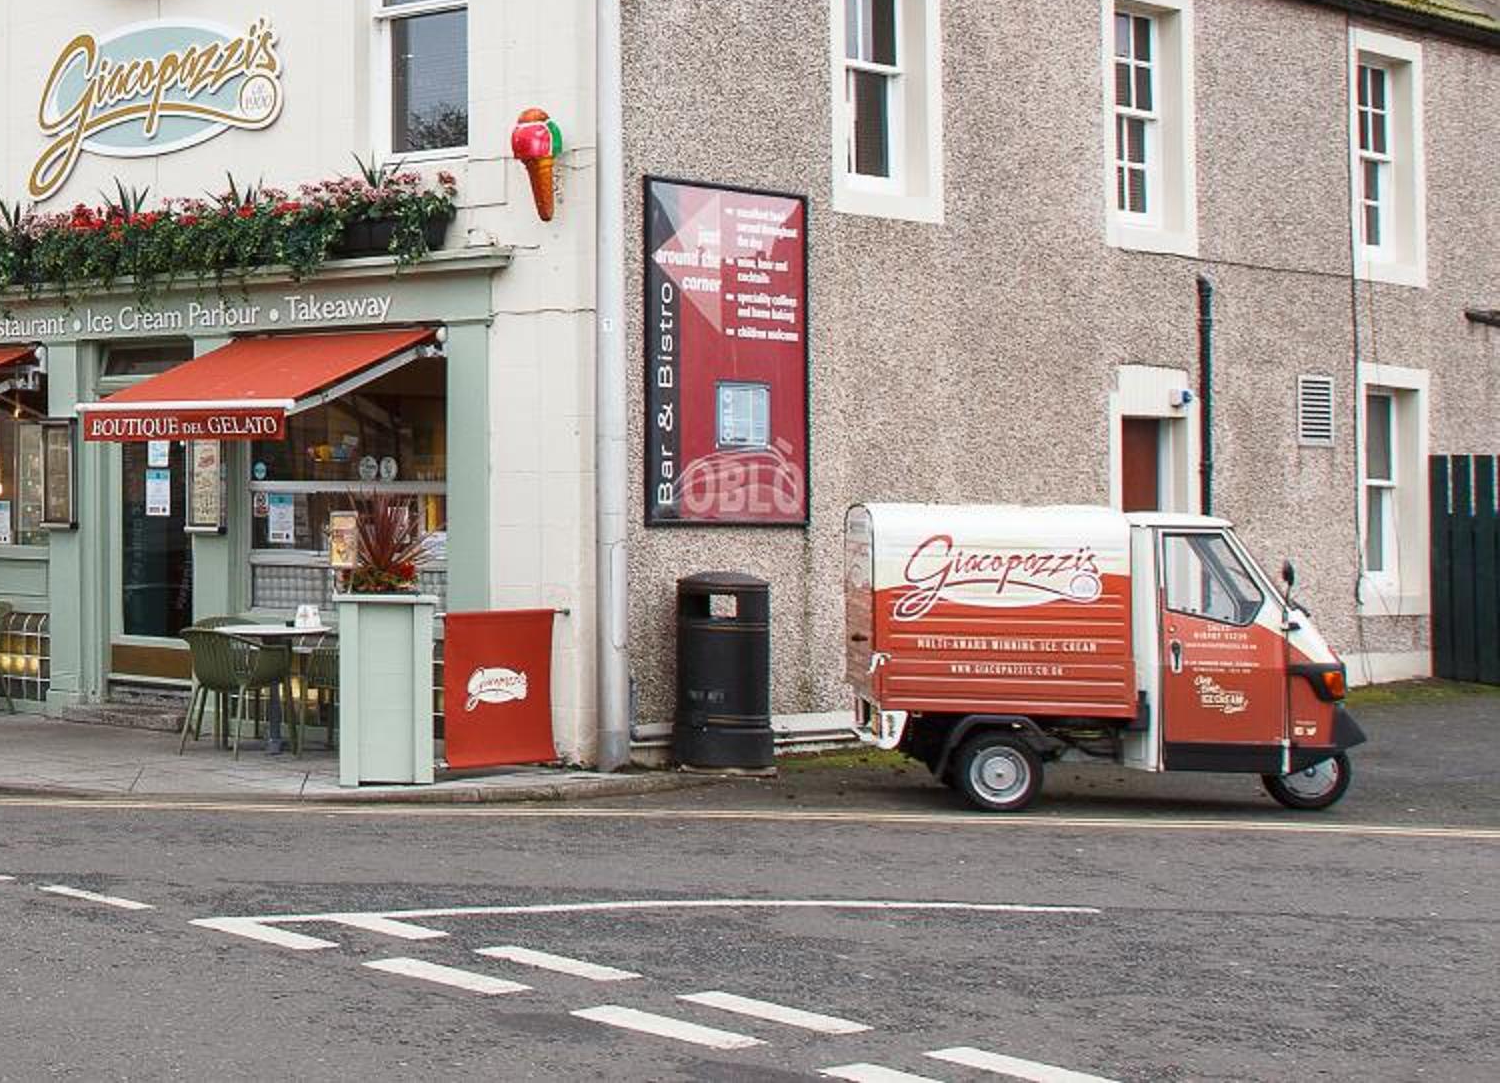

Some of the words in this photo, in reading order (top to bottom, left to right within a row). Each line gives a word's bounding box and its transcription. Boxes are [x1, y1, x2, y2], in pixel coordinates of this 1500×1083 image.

[29, 17, 278, 198] Giacopazzi's
[654, 248, 699, 267] around
[682, 275, 723, 292] corner
[87, 308, 113, 333] Ice
[118, 305, 182, 331] Cream
[189, 301, 261, 327] Parlour
[284, 294, 392, 323] Takeaway
[657, 281, 674, 388] Bistro
[91, 418, 179, 437] BOUTIQUE
[182, 421, 204, 434] DEL
[207, 416, 277, 435] GELATO
[657, 402, 674, 432] &
[657, 444, 674, 505] Bar
[896, 534, 1099, 618] Giacopazzi's
[917, 638, 988, 650] MULTI-AWARD
[991, 639, 1035, 651] WINNING
[1041, 640, 1058, 652] ICE
[1063, 641, 1097, 652] CREAM
